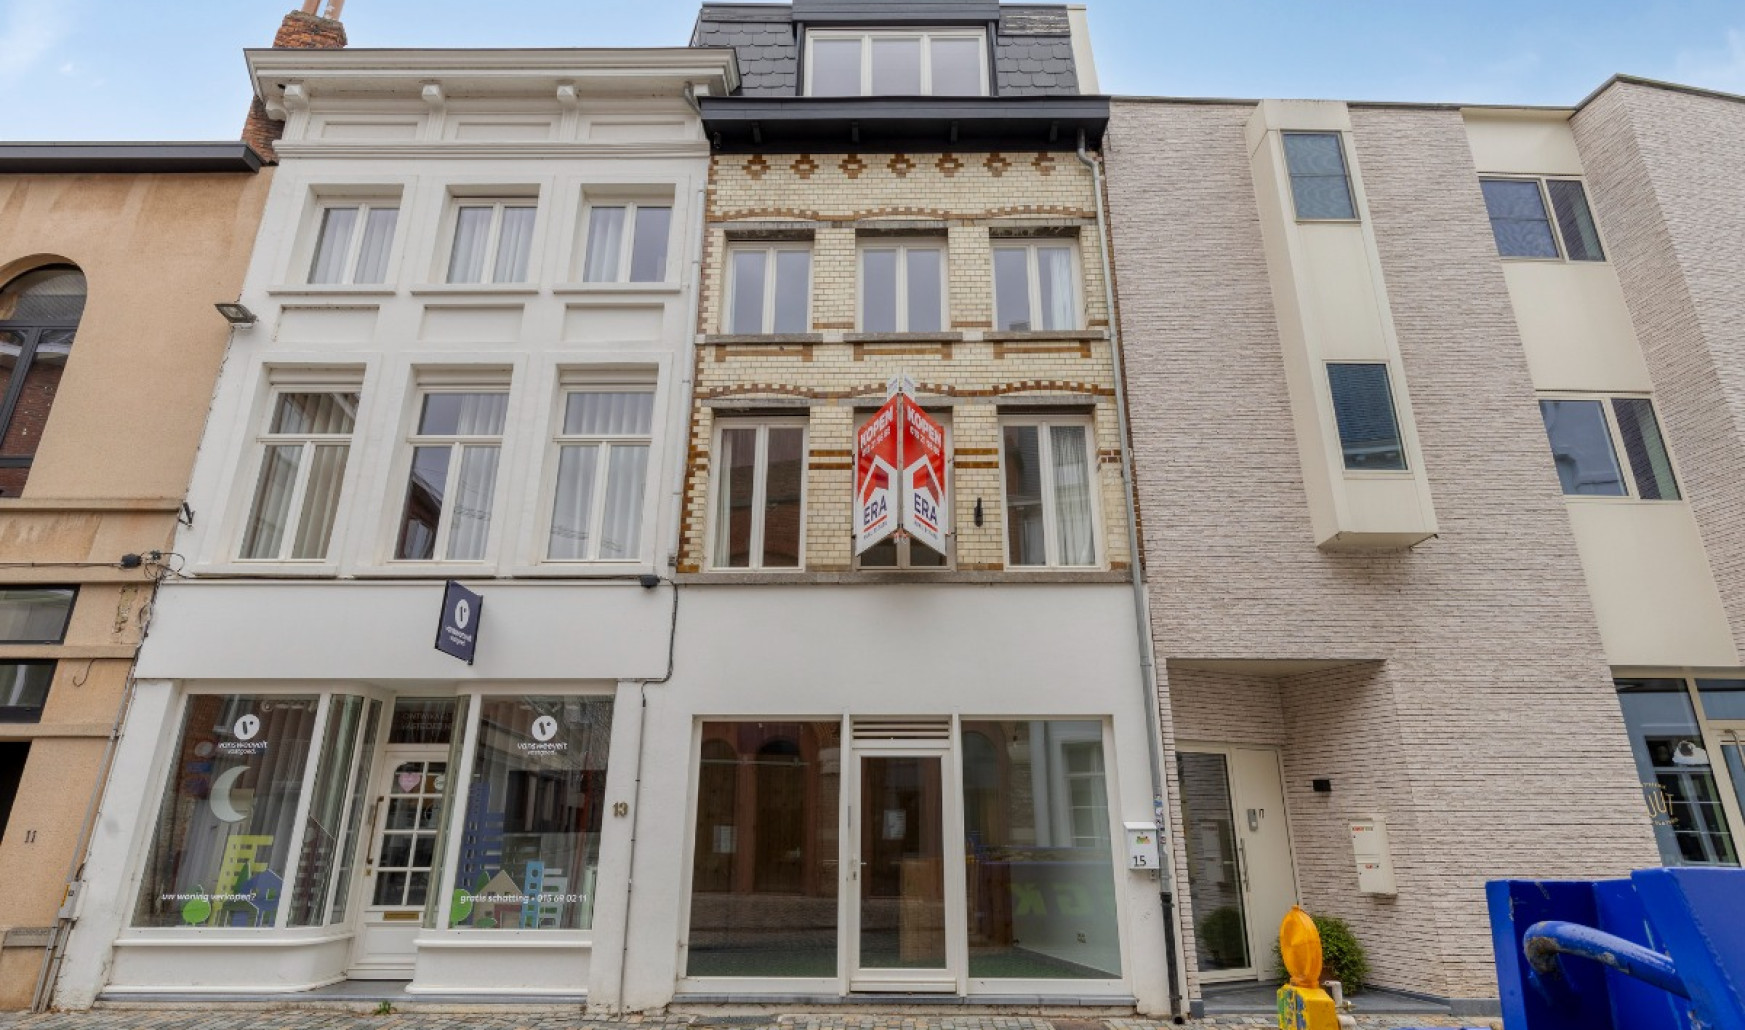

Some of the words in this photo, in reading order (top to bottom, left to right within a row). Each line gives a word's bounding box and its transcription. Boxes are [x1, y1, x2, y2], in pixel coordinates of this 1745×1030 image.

[861, 405, 894, 449] KOPEN
[906, 405, 941, 448] KOPEN
[863, 494, 887, 526] ERA
[914, 492, 938, 525] ERA
[613, 802, 628, 817] 13
[24, 829, 37, 844] 11
[1133, 855, 1147, 867] 15
[177, 892, 209, 903] woning
[211, 892, 257, 903] verkopen?
[460, 893, 488, 904] gratis
[489, 893, 529, 904] schatting
[579, 894, 587, 903] 11
